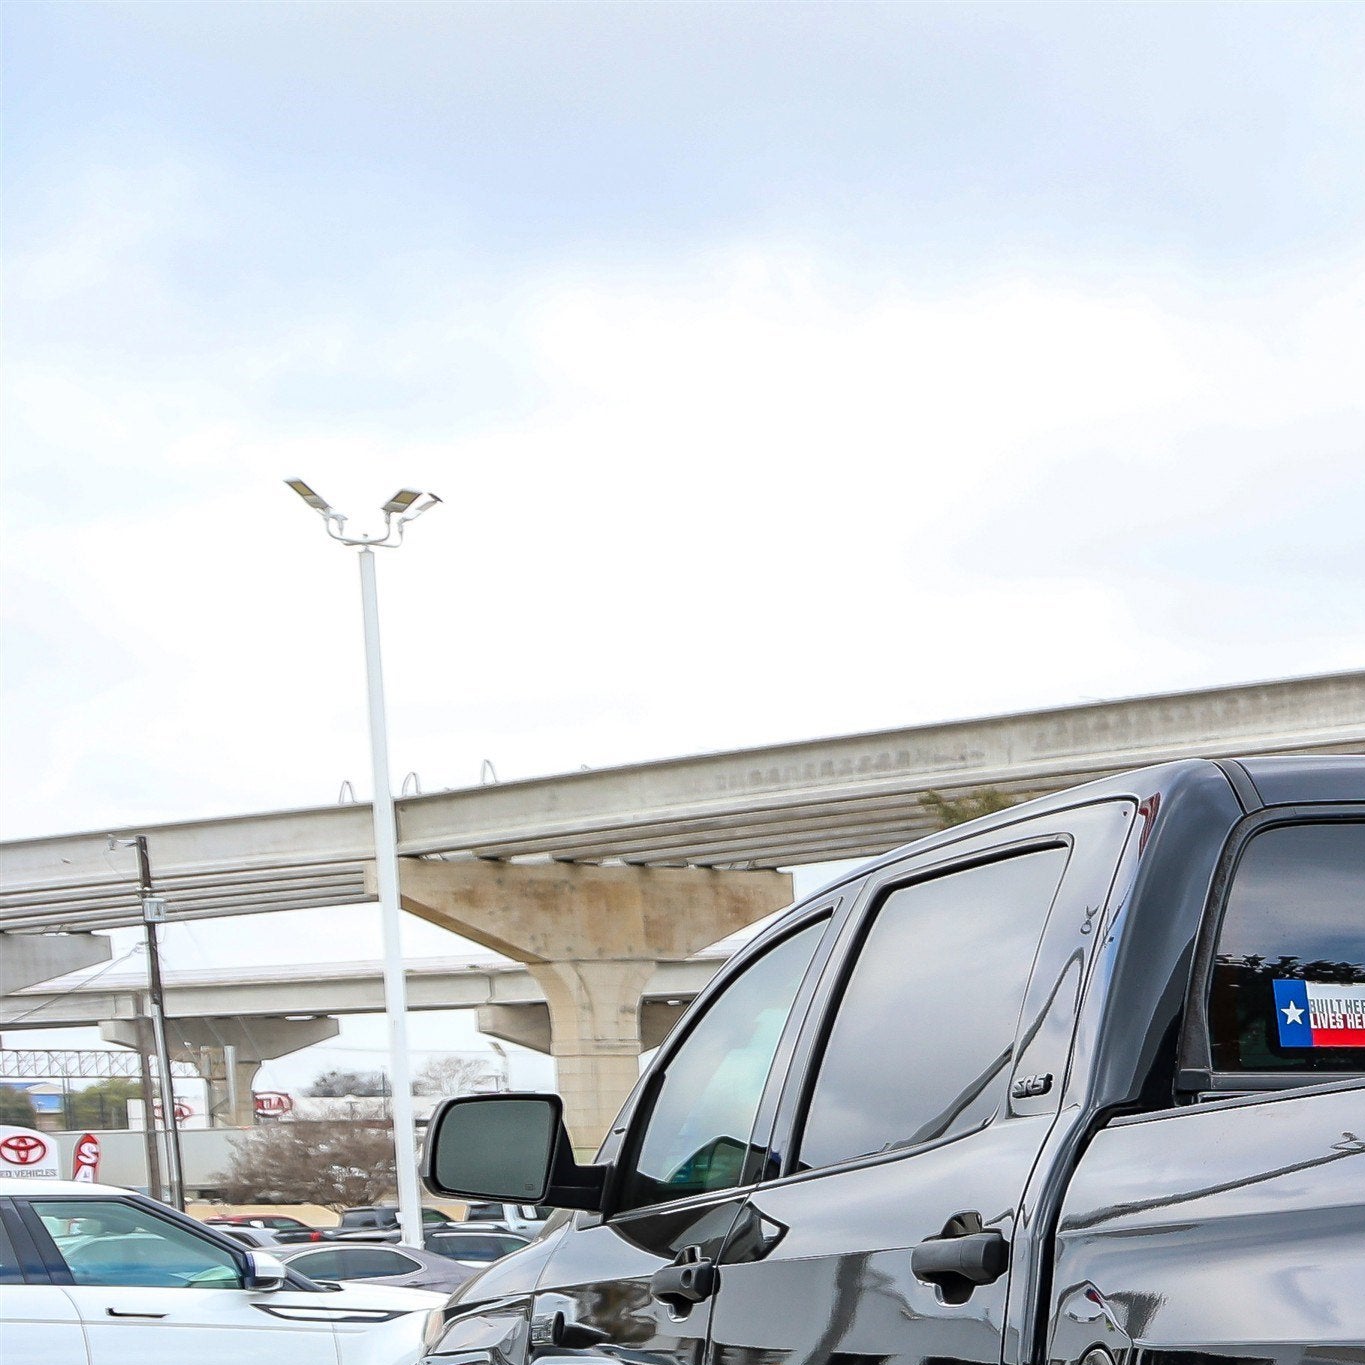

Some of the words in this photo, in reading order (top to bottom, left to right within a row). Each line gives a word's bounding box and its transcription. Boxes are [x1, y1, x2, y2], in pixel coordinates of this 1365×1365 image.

[1309, 1000, 1343, 1014] BUILT
[1310, 1014, 1345, 1028] LIVES
[15, 1169, 57, 1177] VEHICLES
